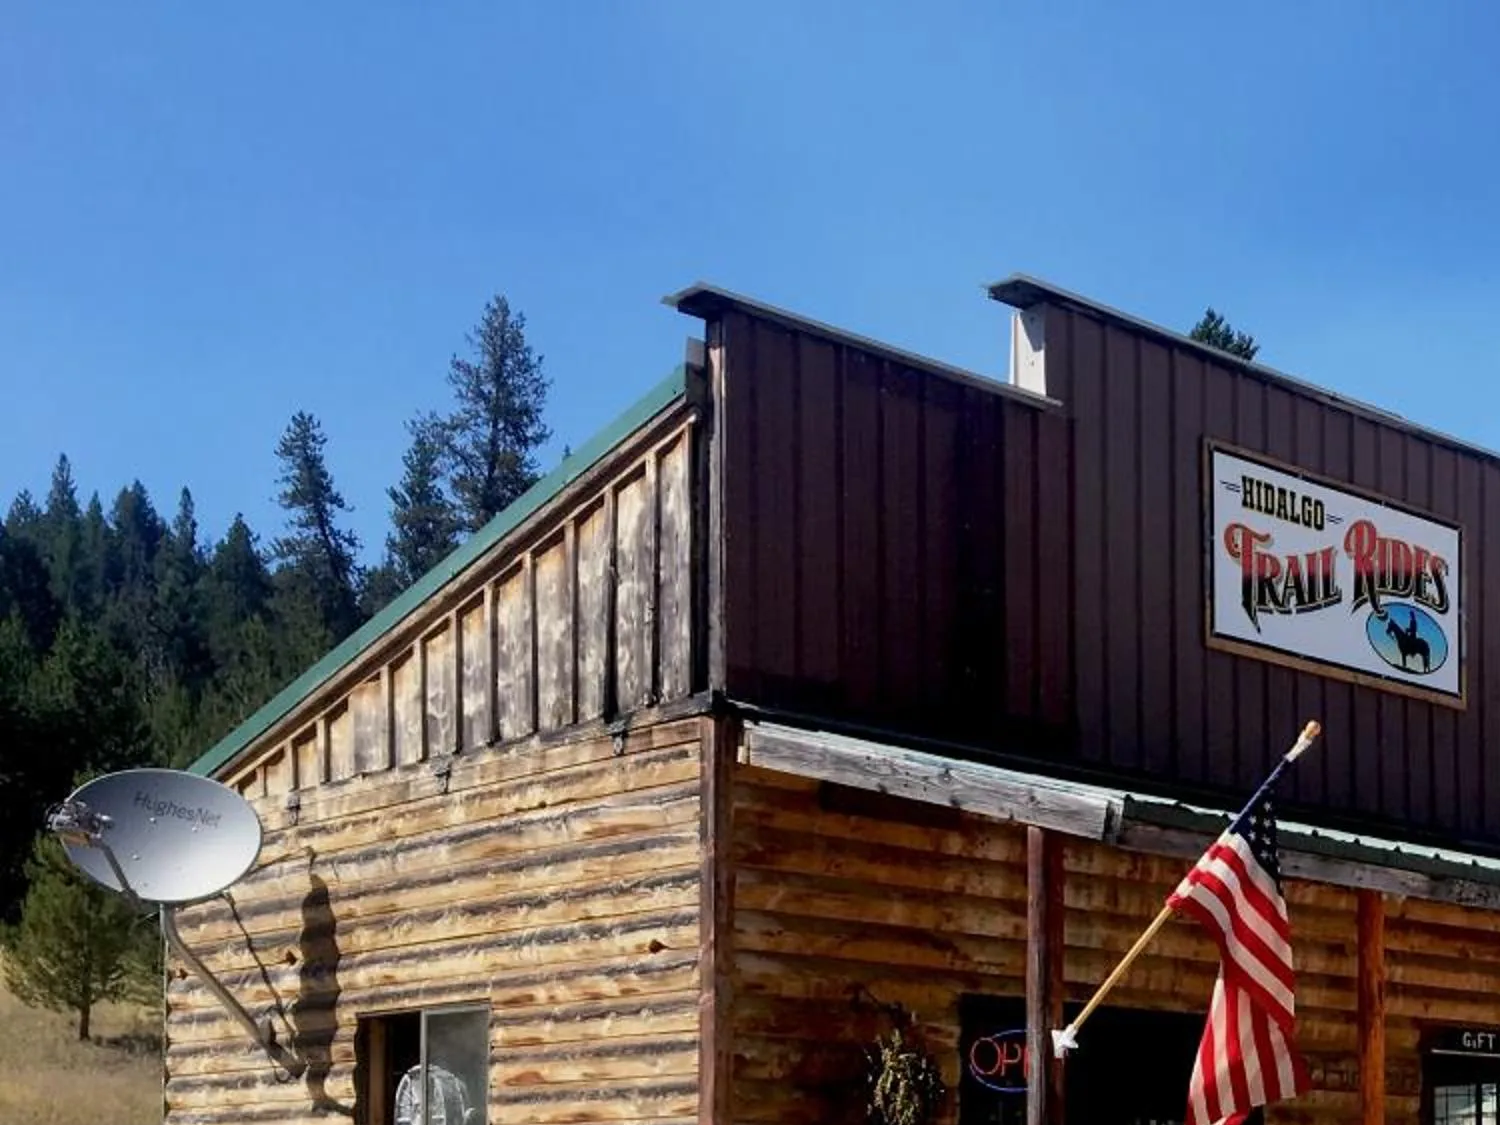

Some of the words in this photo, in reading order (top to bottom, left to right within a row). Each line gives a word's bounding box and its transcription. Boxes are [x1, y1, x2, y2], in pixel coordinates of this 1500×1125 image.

[1241, 475, 1325, 531] HIDALGO
[1224, 522, 1342, 634] TRAIL
[1344, 519, 1449, 621] RIDES
[133, 790, 222, 829] HughesNet
